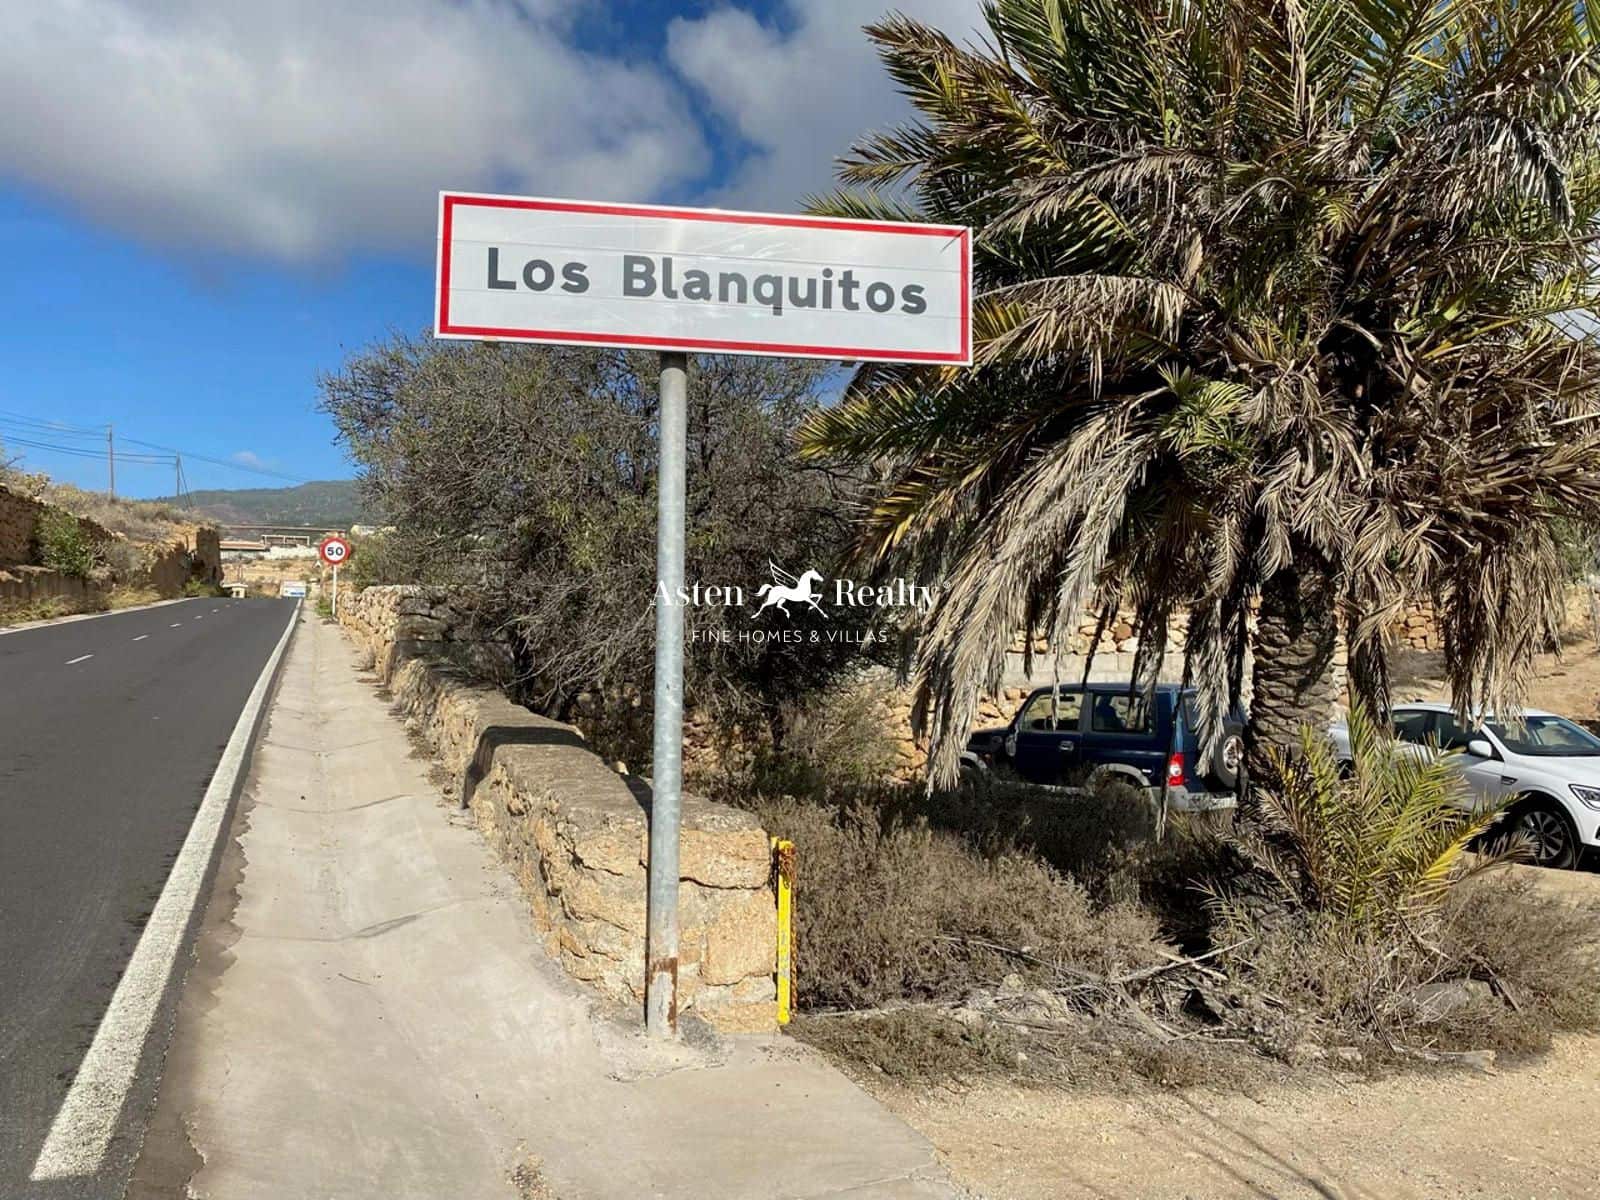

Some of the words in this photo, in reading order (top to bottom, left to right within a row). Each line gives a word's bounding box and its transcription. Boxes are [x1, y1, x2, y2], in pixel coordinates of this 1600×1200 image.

[487, 247, 590, 294] Los
[622, 254, 928, 317] Blanquitos
[327, 546, 344, 557] 50
